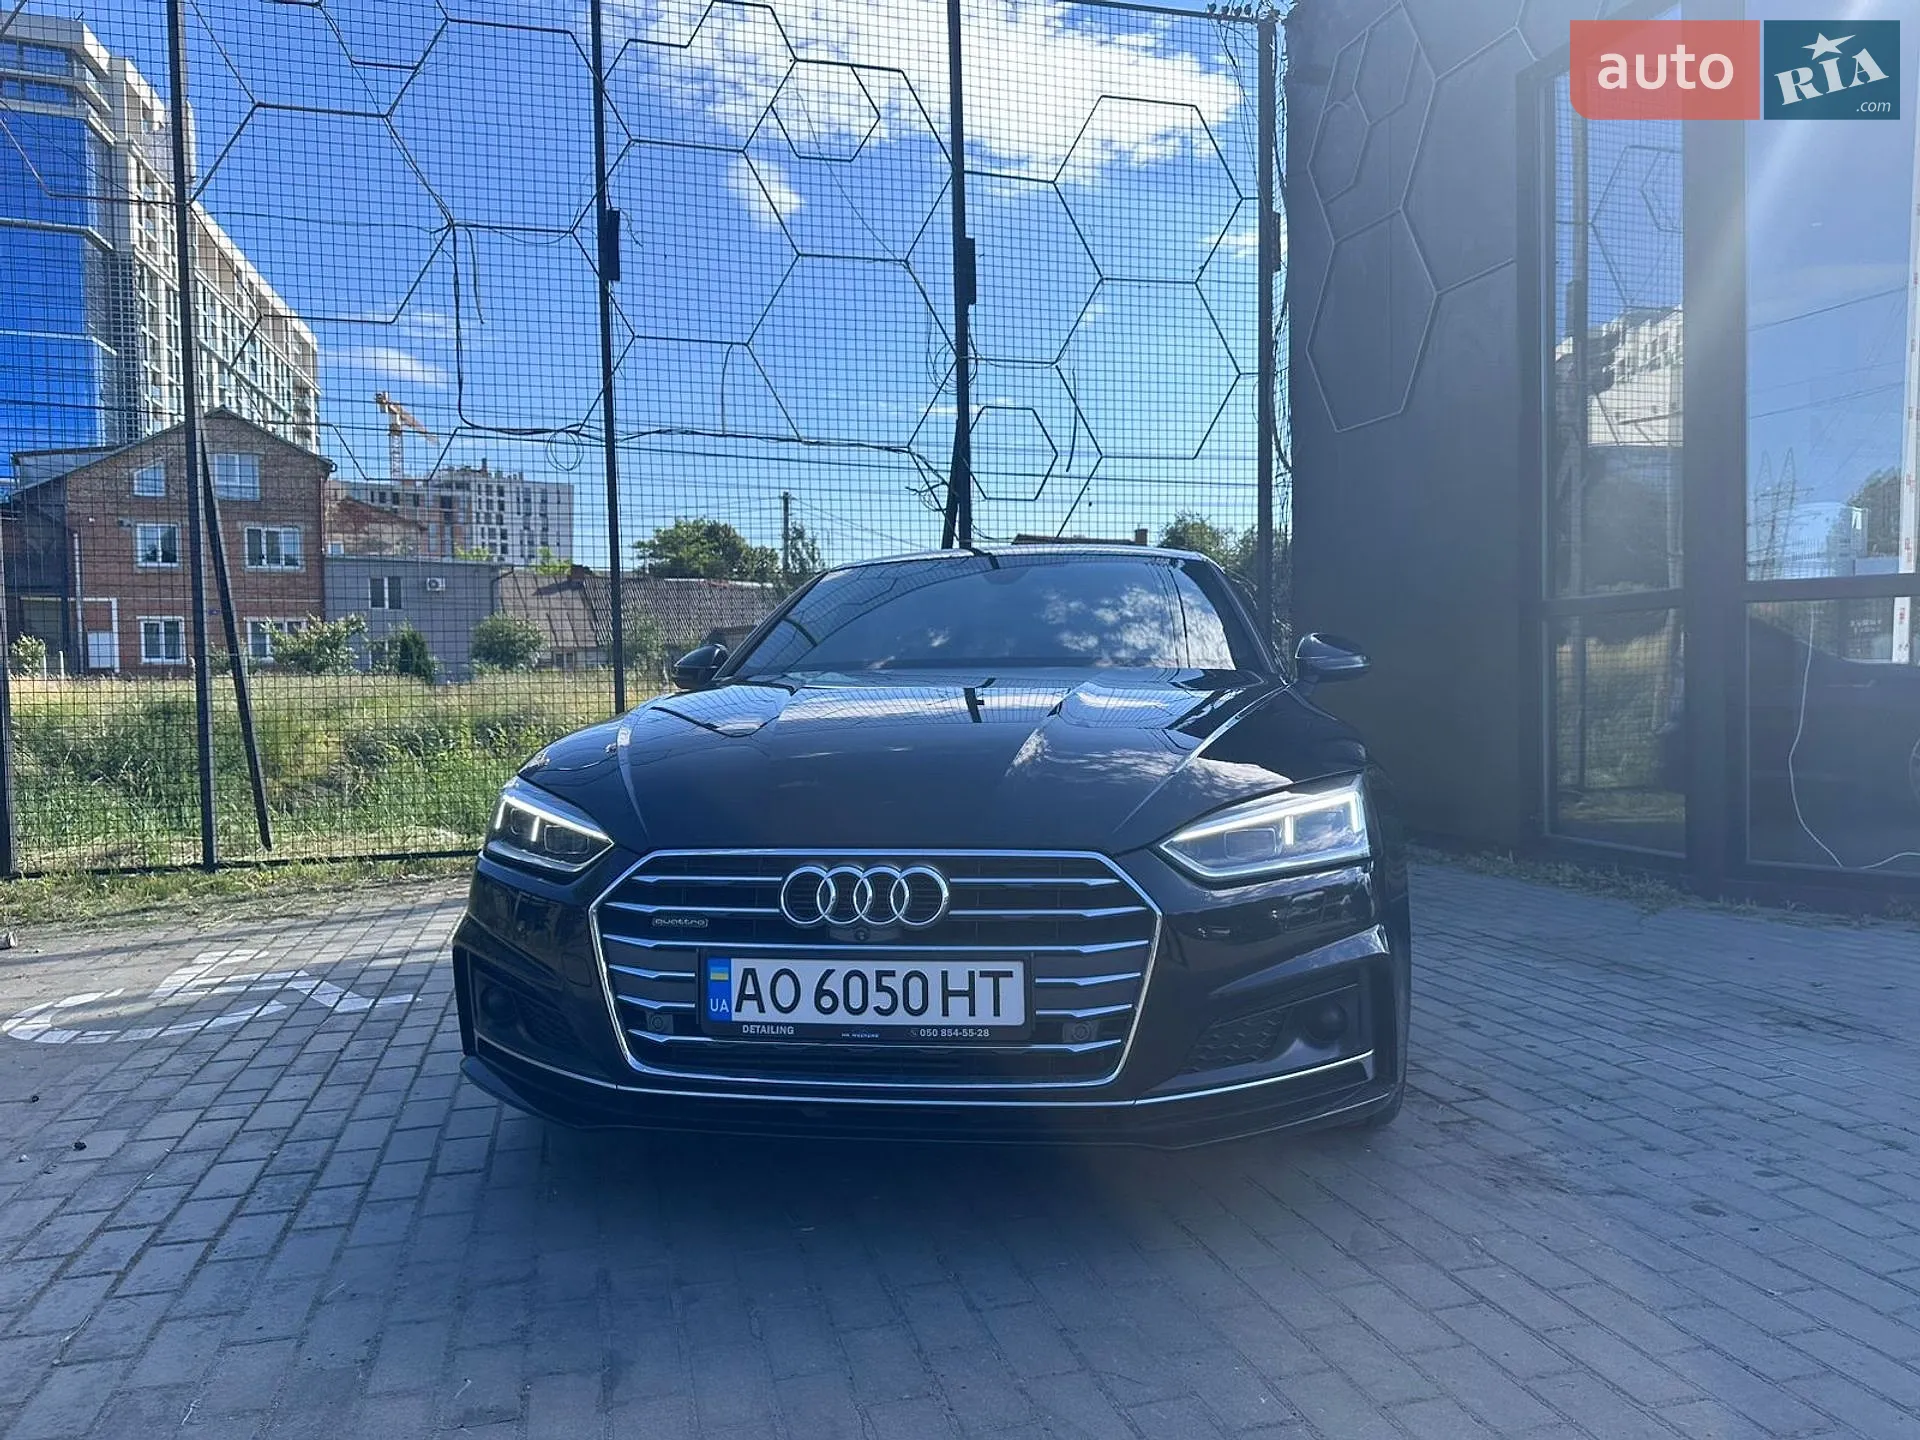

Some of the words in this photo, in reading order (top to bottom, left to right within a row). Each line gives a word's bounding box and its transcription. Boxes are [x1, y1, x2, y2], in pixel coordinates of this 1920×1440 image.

[735, 967, 802, 1015] AO
[813, 968, 929, 1017] 6050
[941, 970, 1014, 1018] HT
[710, 998, 730, 1013] UA
[742, 1024, 795, 1035] DETAILING
[920, 1028, 938, 1037] 050
